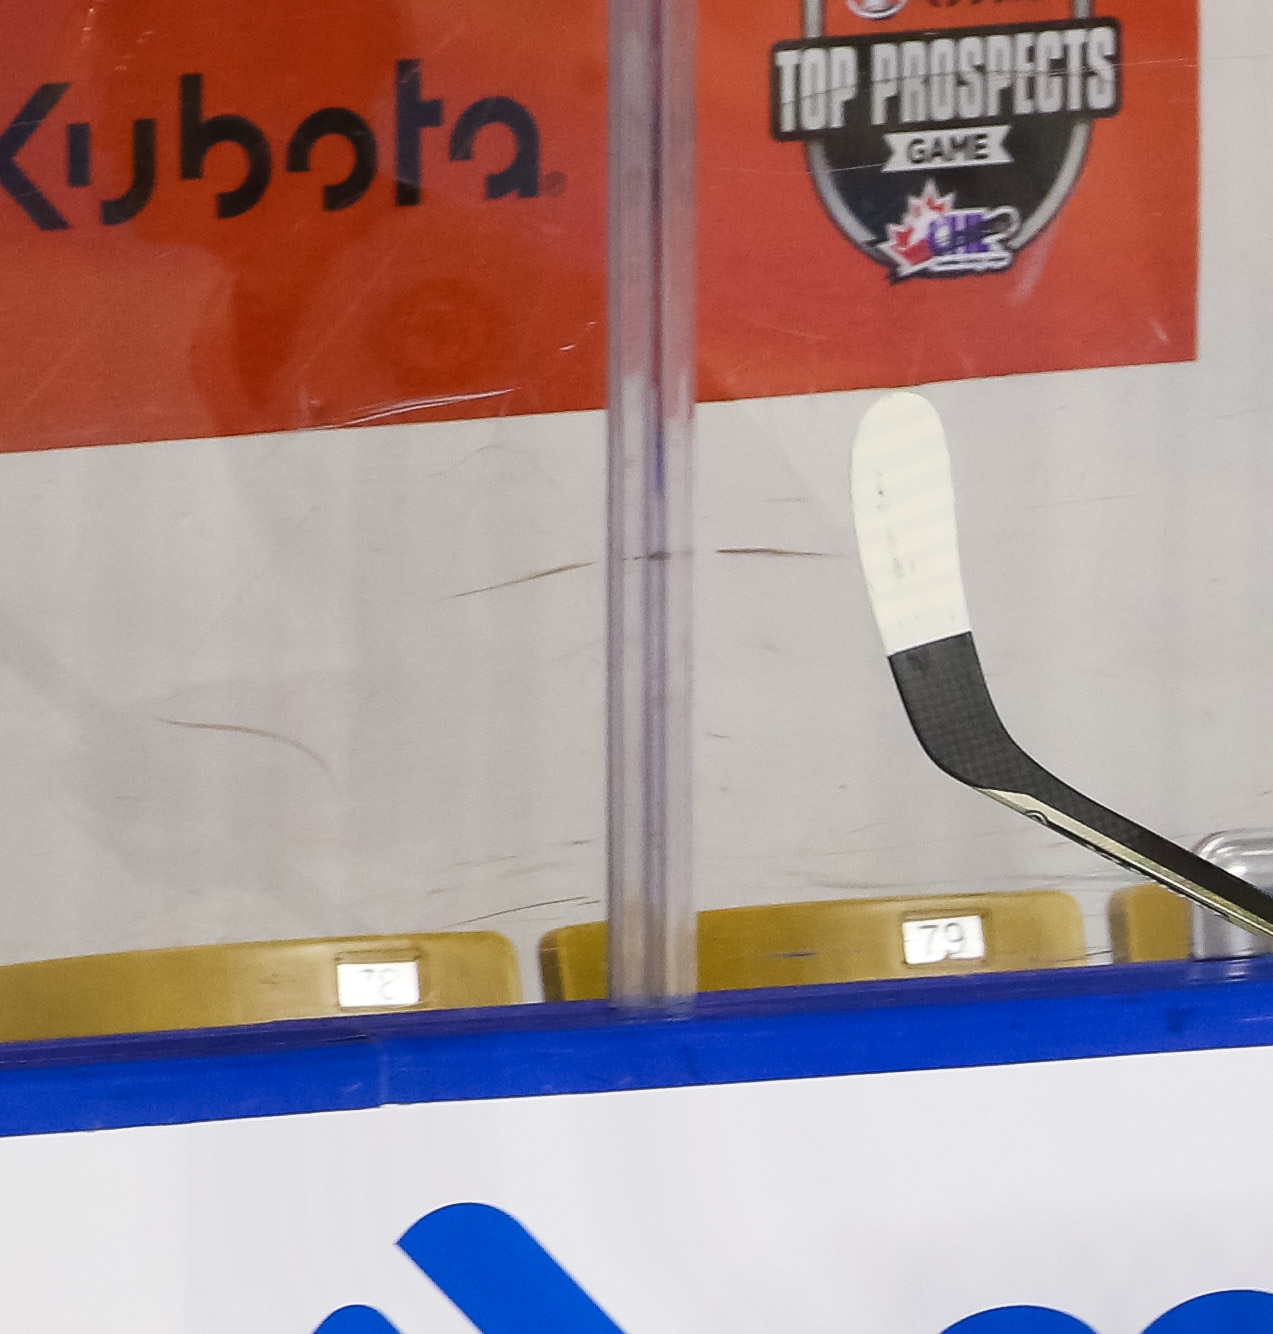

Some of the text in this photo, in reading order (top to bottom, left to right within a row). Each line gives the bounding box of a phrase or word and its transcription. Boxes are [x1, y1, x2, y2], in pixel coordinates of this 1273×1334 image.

[775, 26, 1118, 133] TOP PROSPECTS
[906, 133, 988, 164] GAME
